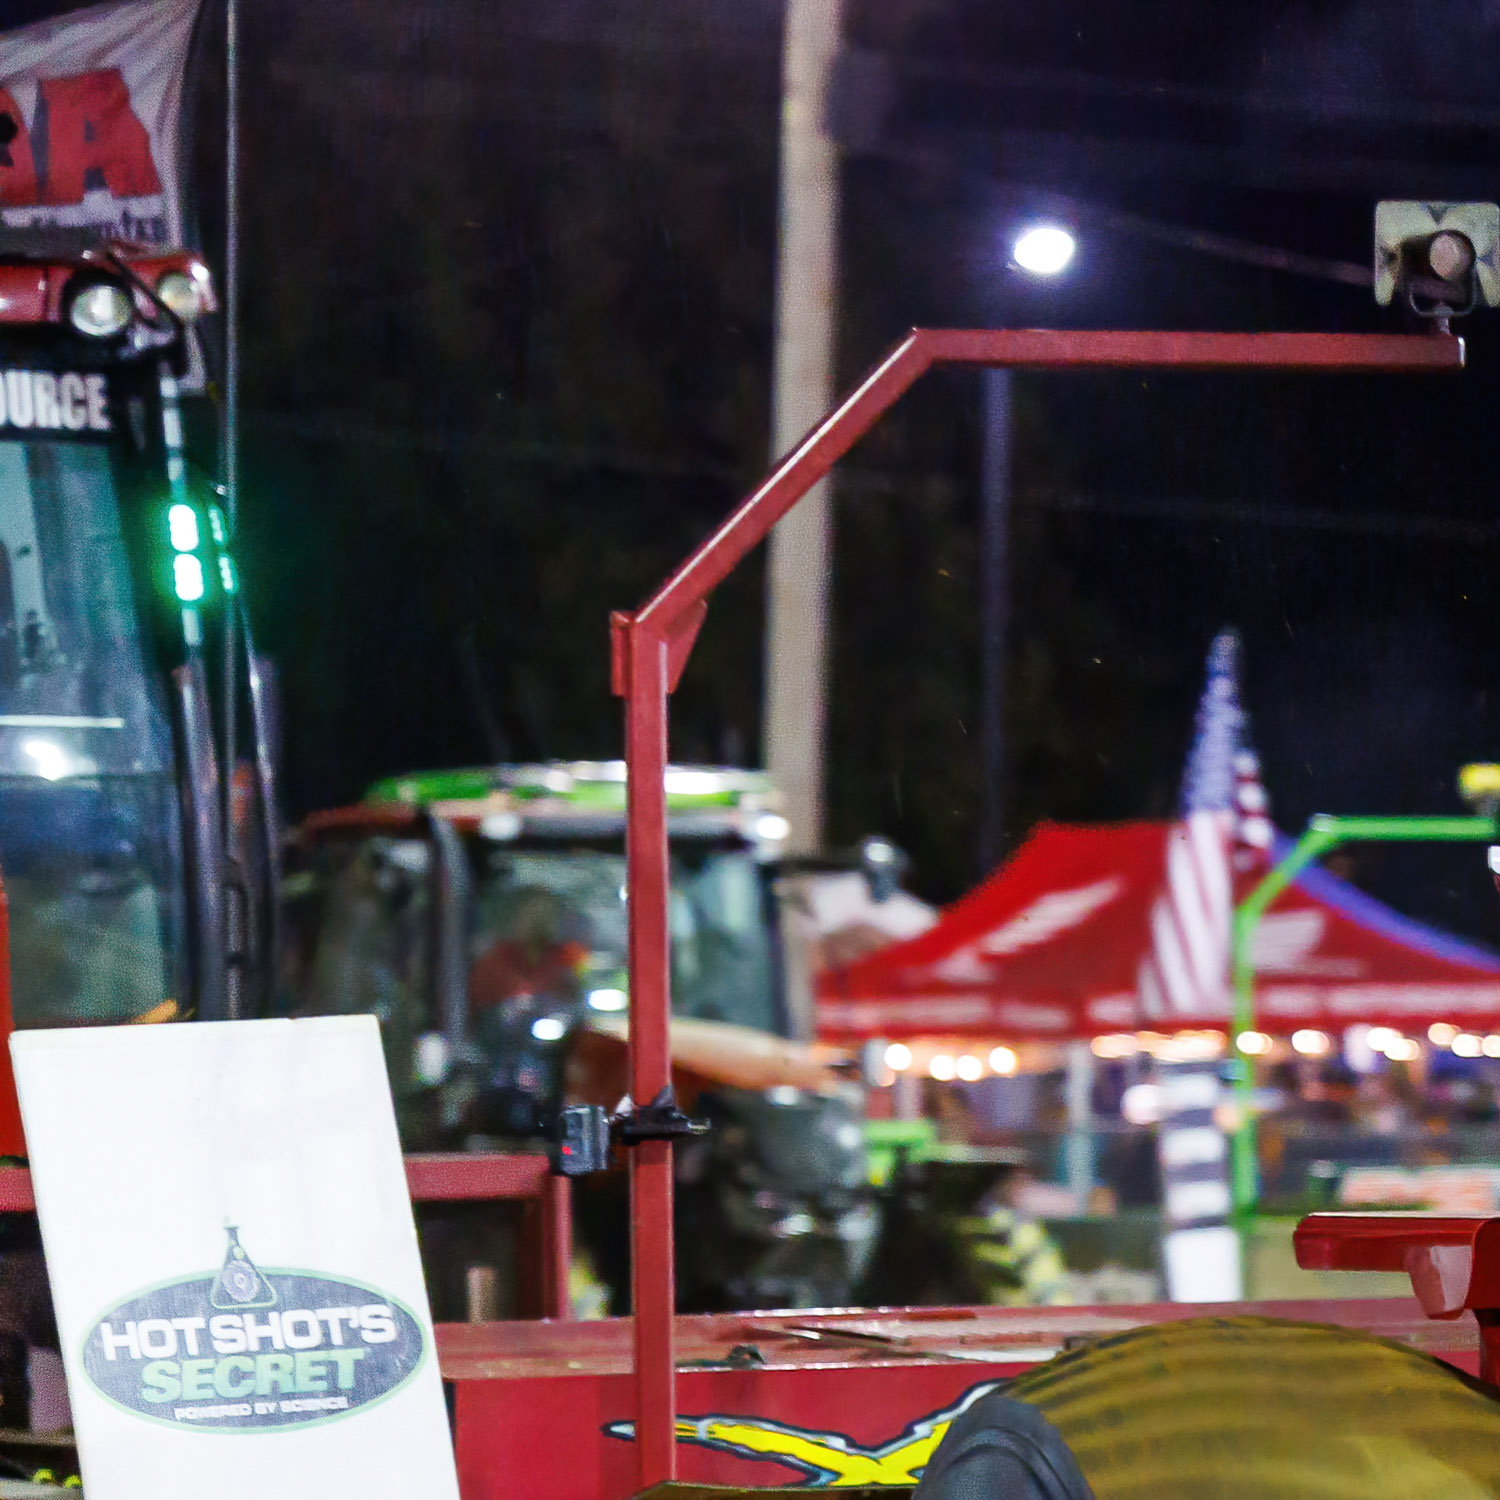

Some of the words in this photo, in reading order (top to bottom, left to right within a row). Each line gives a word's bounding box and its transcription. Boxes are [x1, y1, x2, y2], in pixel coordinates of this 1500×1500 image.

[0, 369, 112, 430] URCE
[100, 1316, 206, 1361] HOT
[208, 1303, 399, 1355] SHOT'S
[140, 1348, 370, 1404] SECRET
